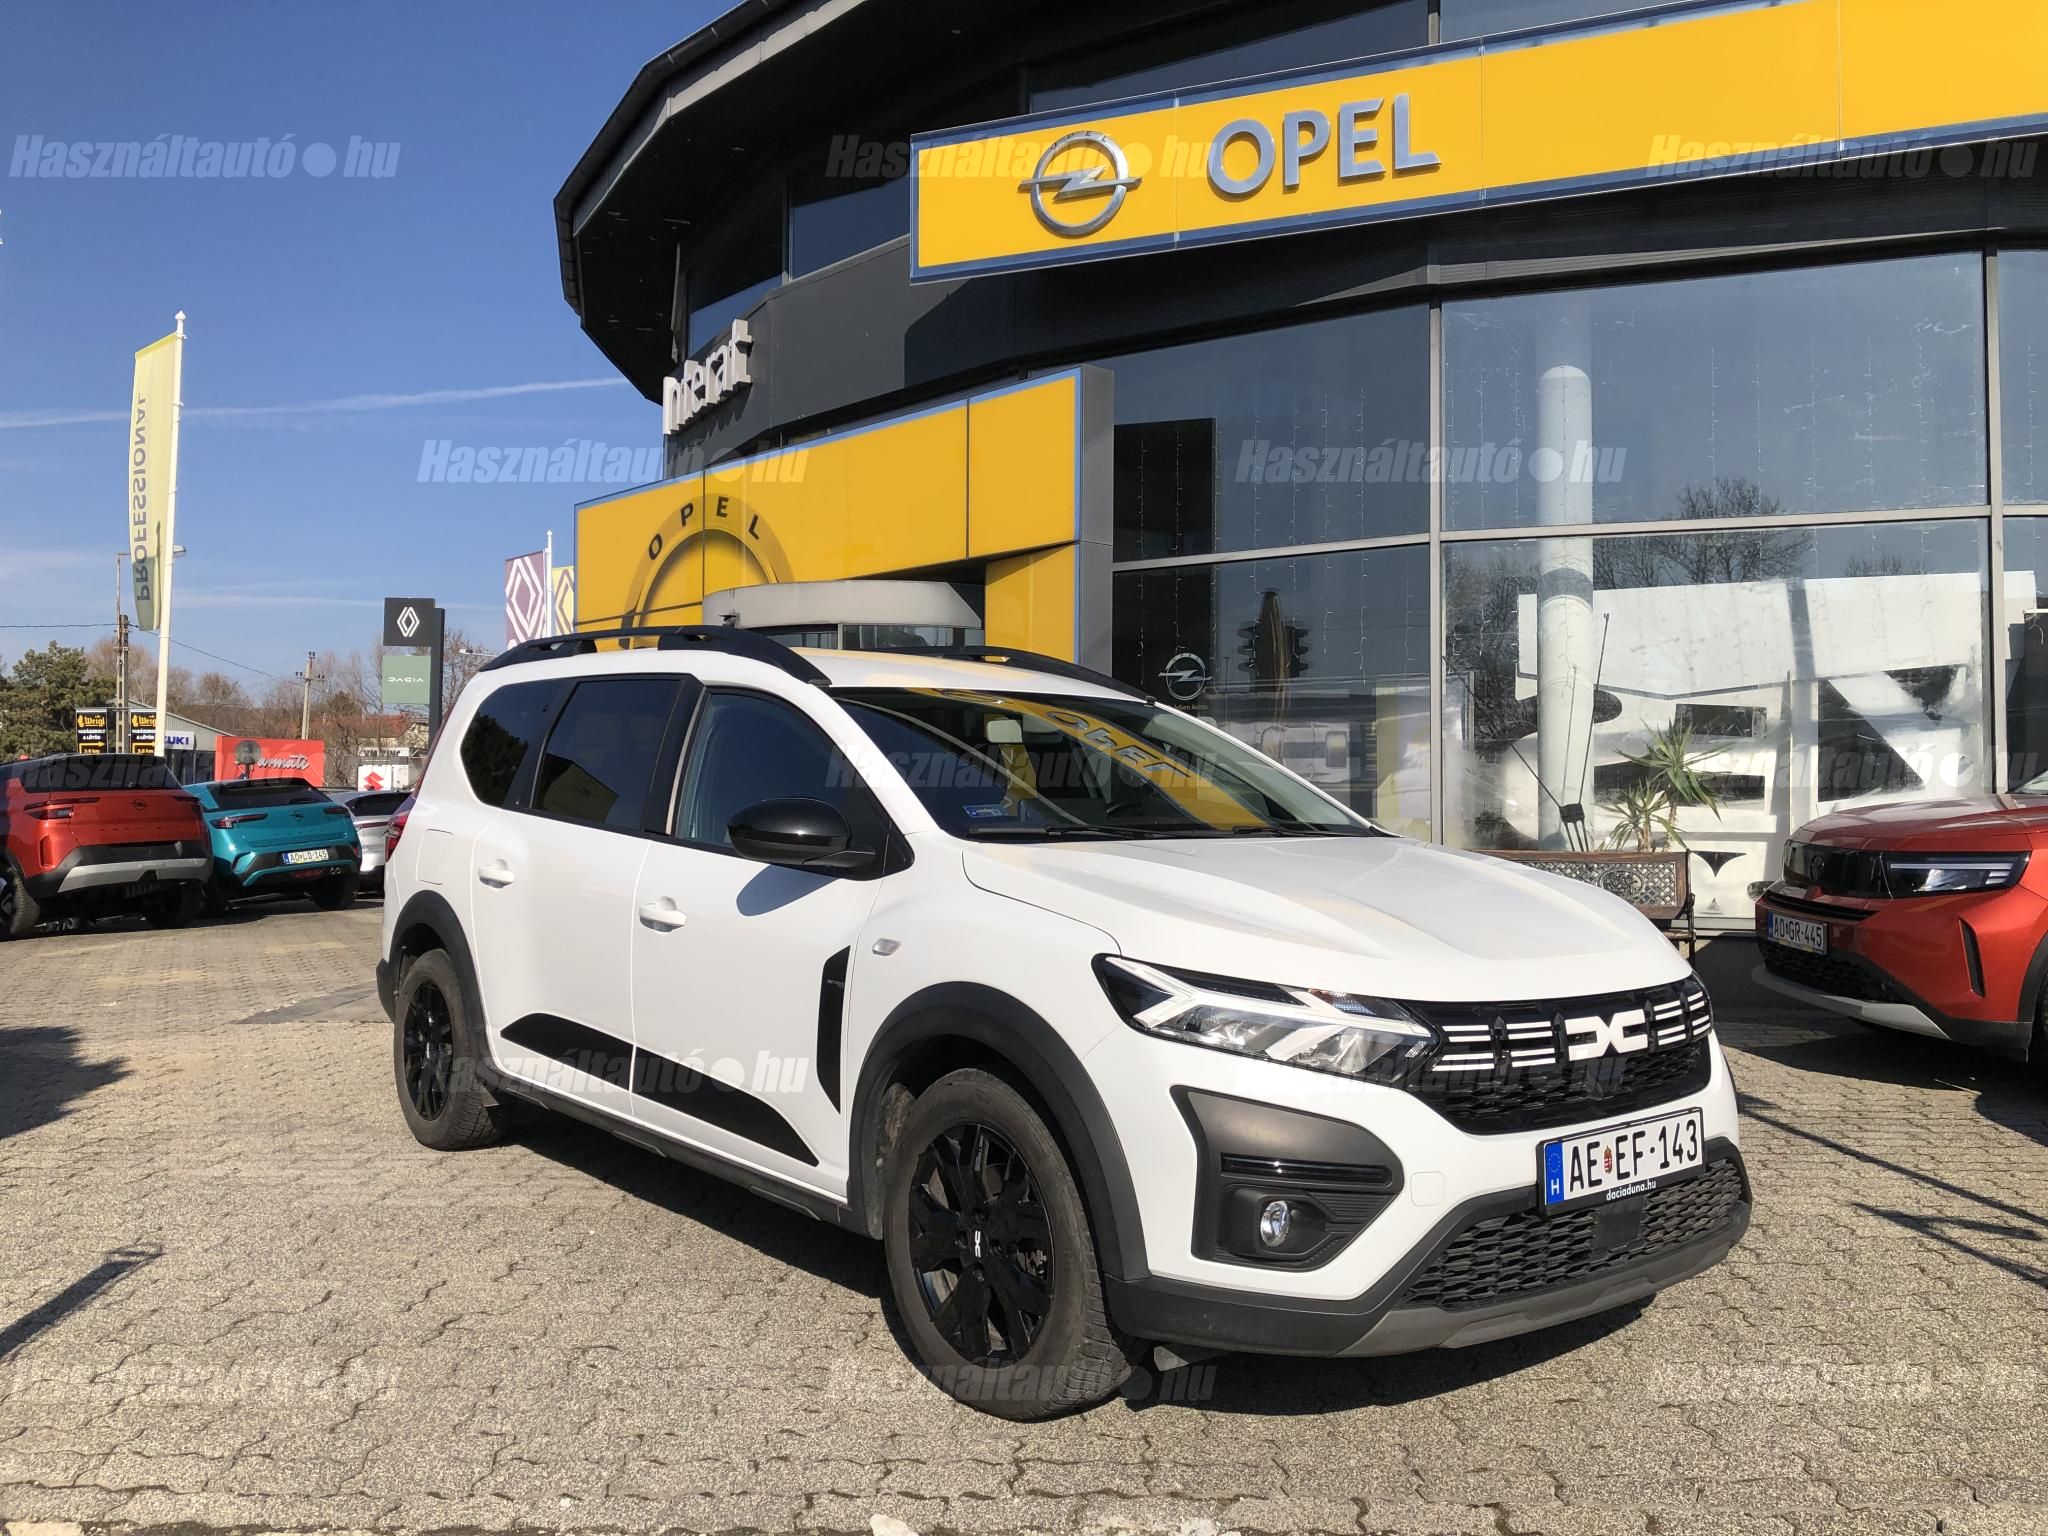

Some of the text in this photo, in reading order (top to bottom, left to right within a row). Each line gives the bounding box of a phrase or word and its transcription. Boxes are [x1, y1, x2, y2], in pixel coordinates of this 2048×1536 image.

[1207, 92, 1441, 196] OPEL
[649, 496, 760, 560] OPEL
[84, 715, 105, 727] Weigl
[138, 715, 157, 727] Weig
[1551, 1178, 1560, 1195] H
[1606, 1181, 1657, 1200] daciaduna.hu
